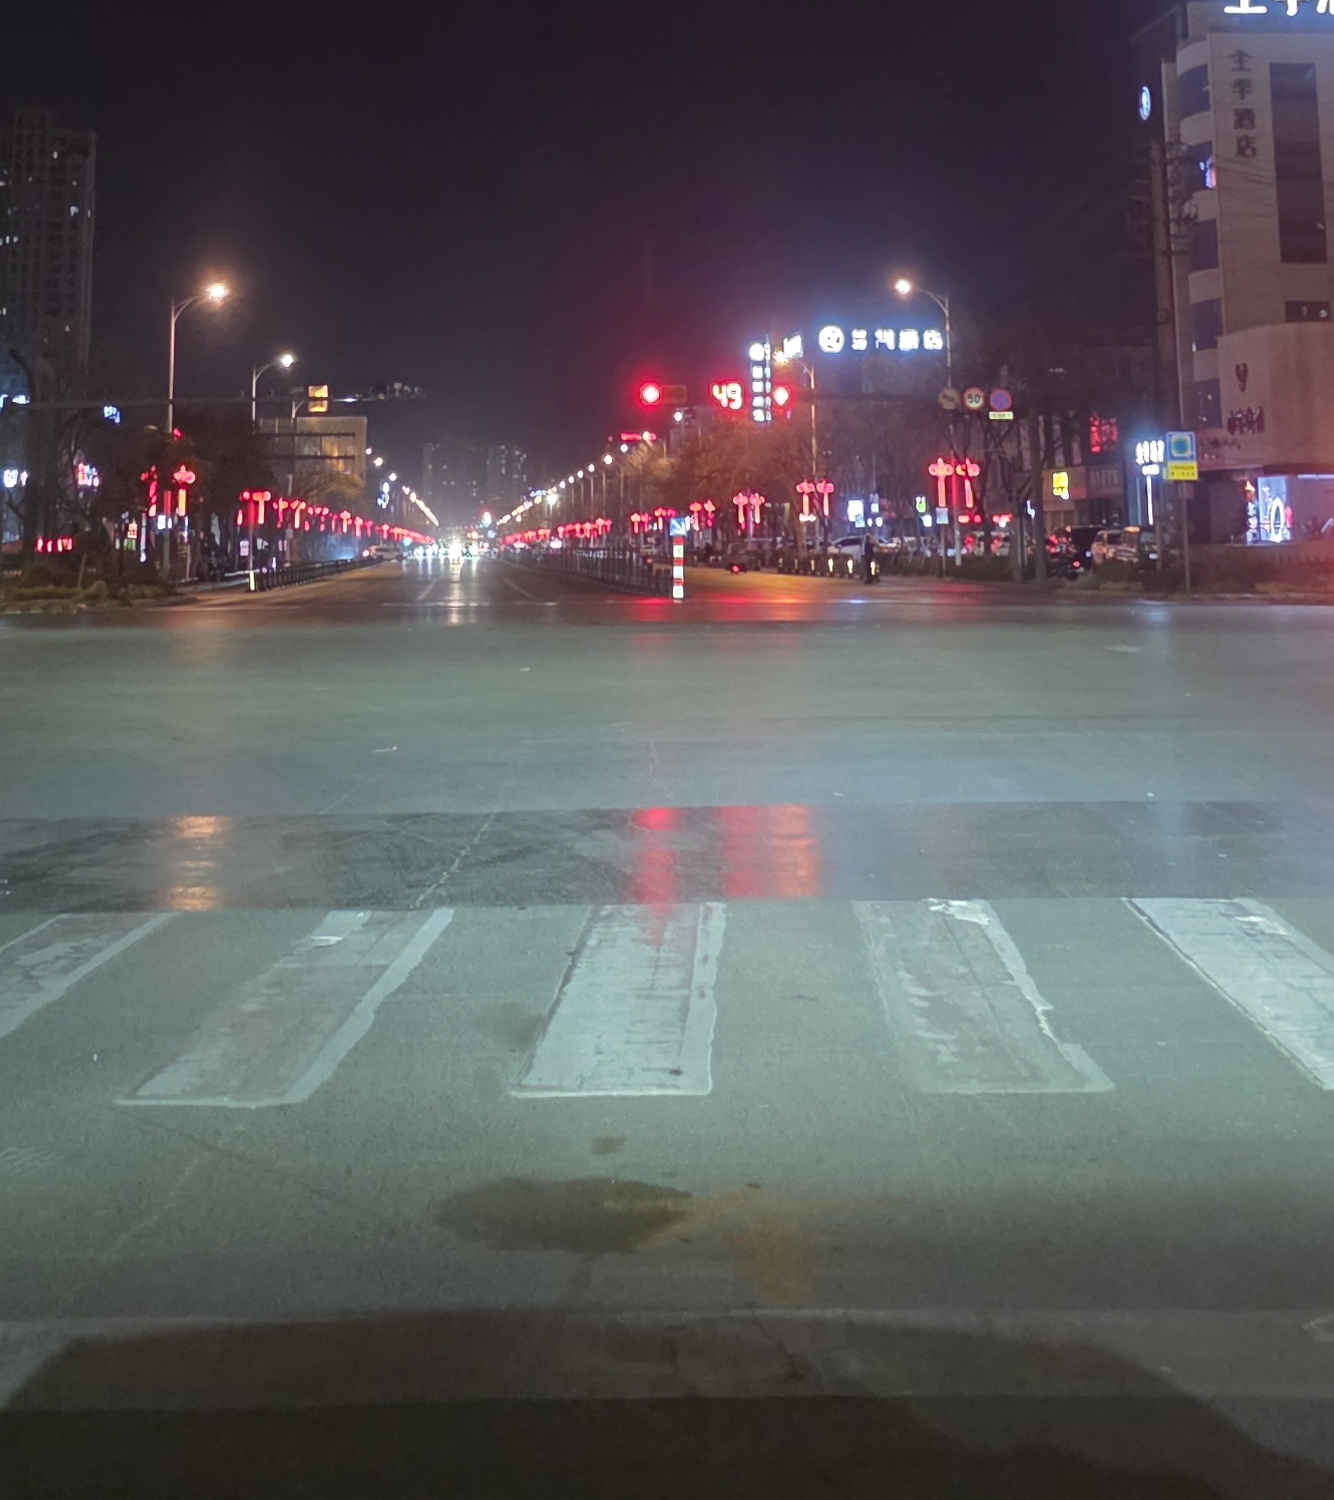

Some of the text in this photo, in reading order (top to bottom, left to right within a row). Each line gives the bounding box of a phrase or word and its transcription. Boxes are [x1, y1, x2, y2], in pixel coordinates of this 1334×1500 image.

[1228, 49, 1257, 159] 全季酒店
[712, 382, 744, 410] 49
[968, 394, 981, 404] 50
